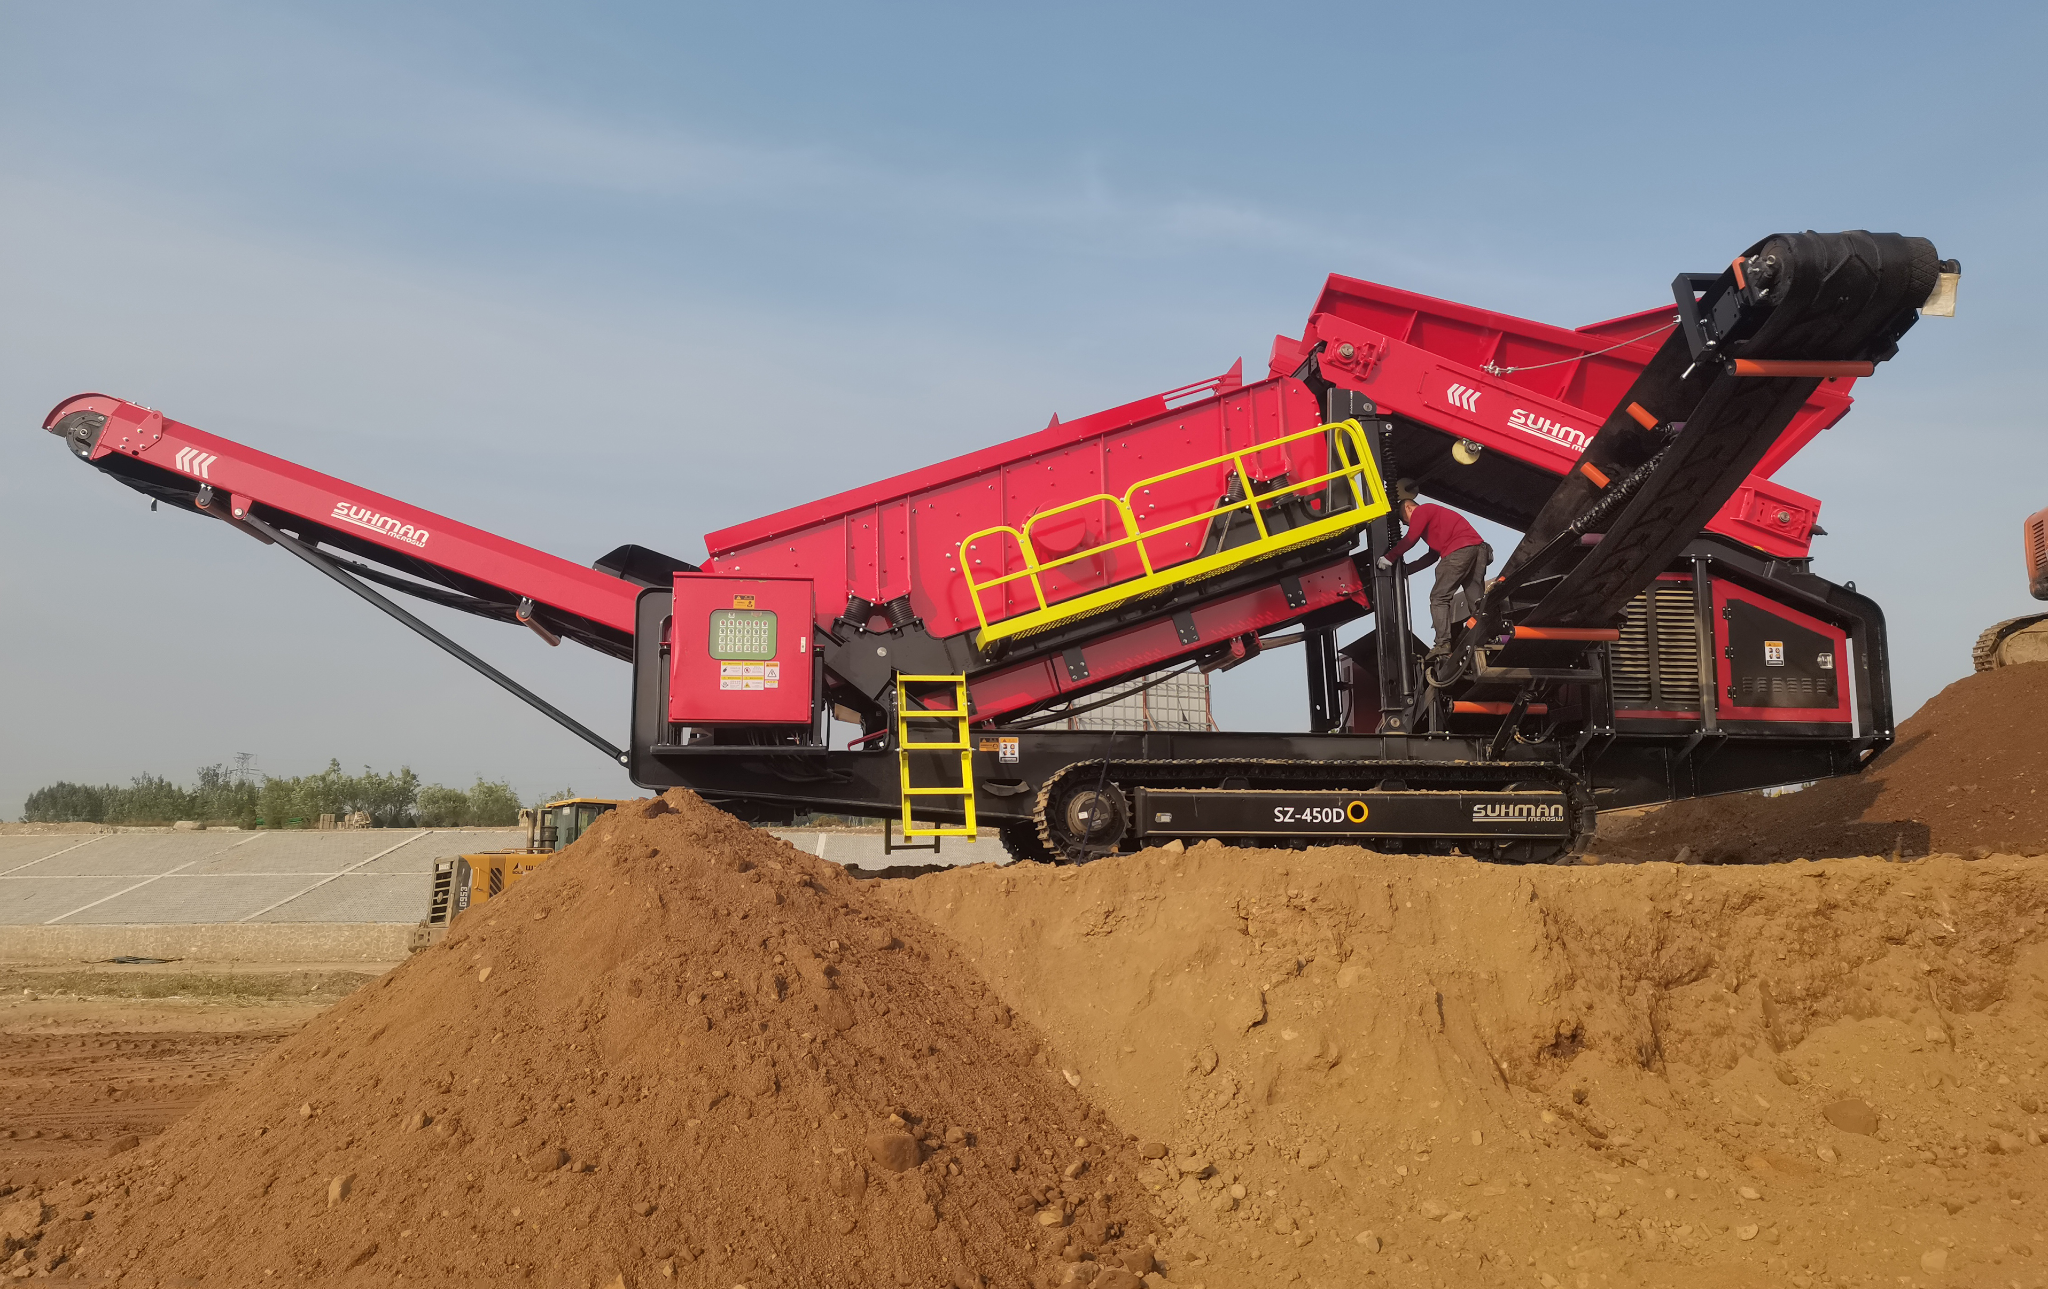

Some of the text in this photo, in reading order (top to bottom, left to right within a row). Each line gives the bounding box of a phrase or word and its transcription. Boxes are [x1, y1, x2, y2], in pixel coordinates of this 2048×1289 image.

[333, 502, 430, 543] SUHMAN
[1274, 807, 1345, 823] SZ-450D
[1472, 804, 1564, 817] SUHMAN
